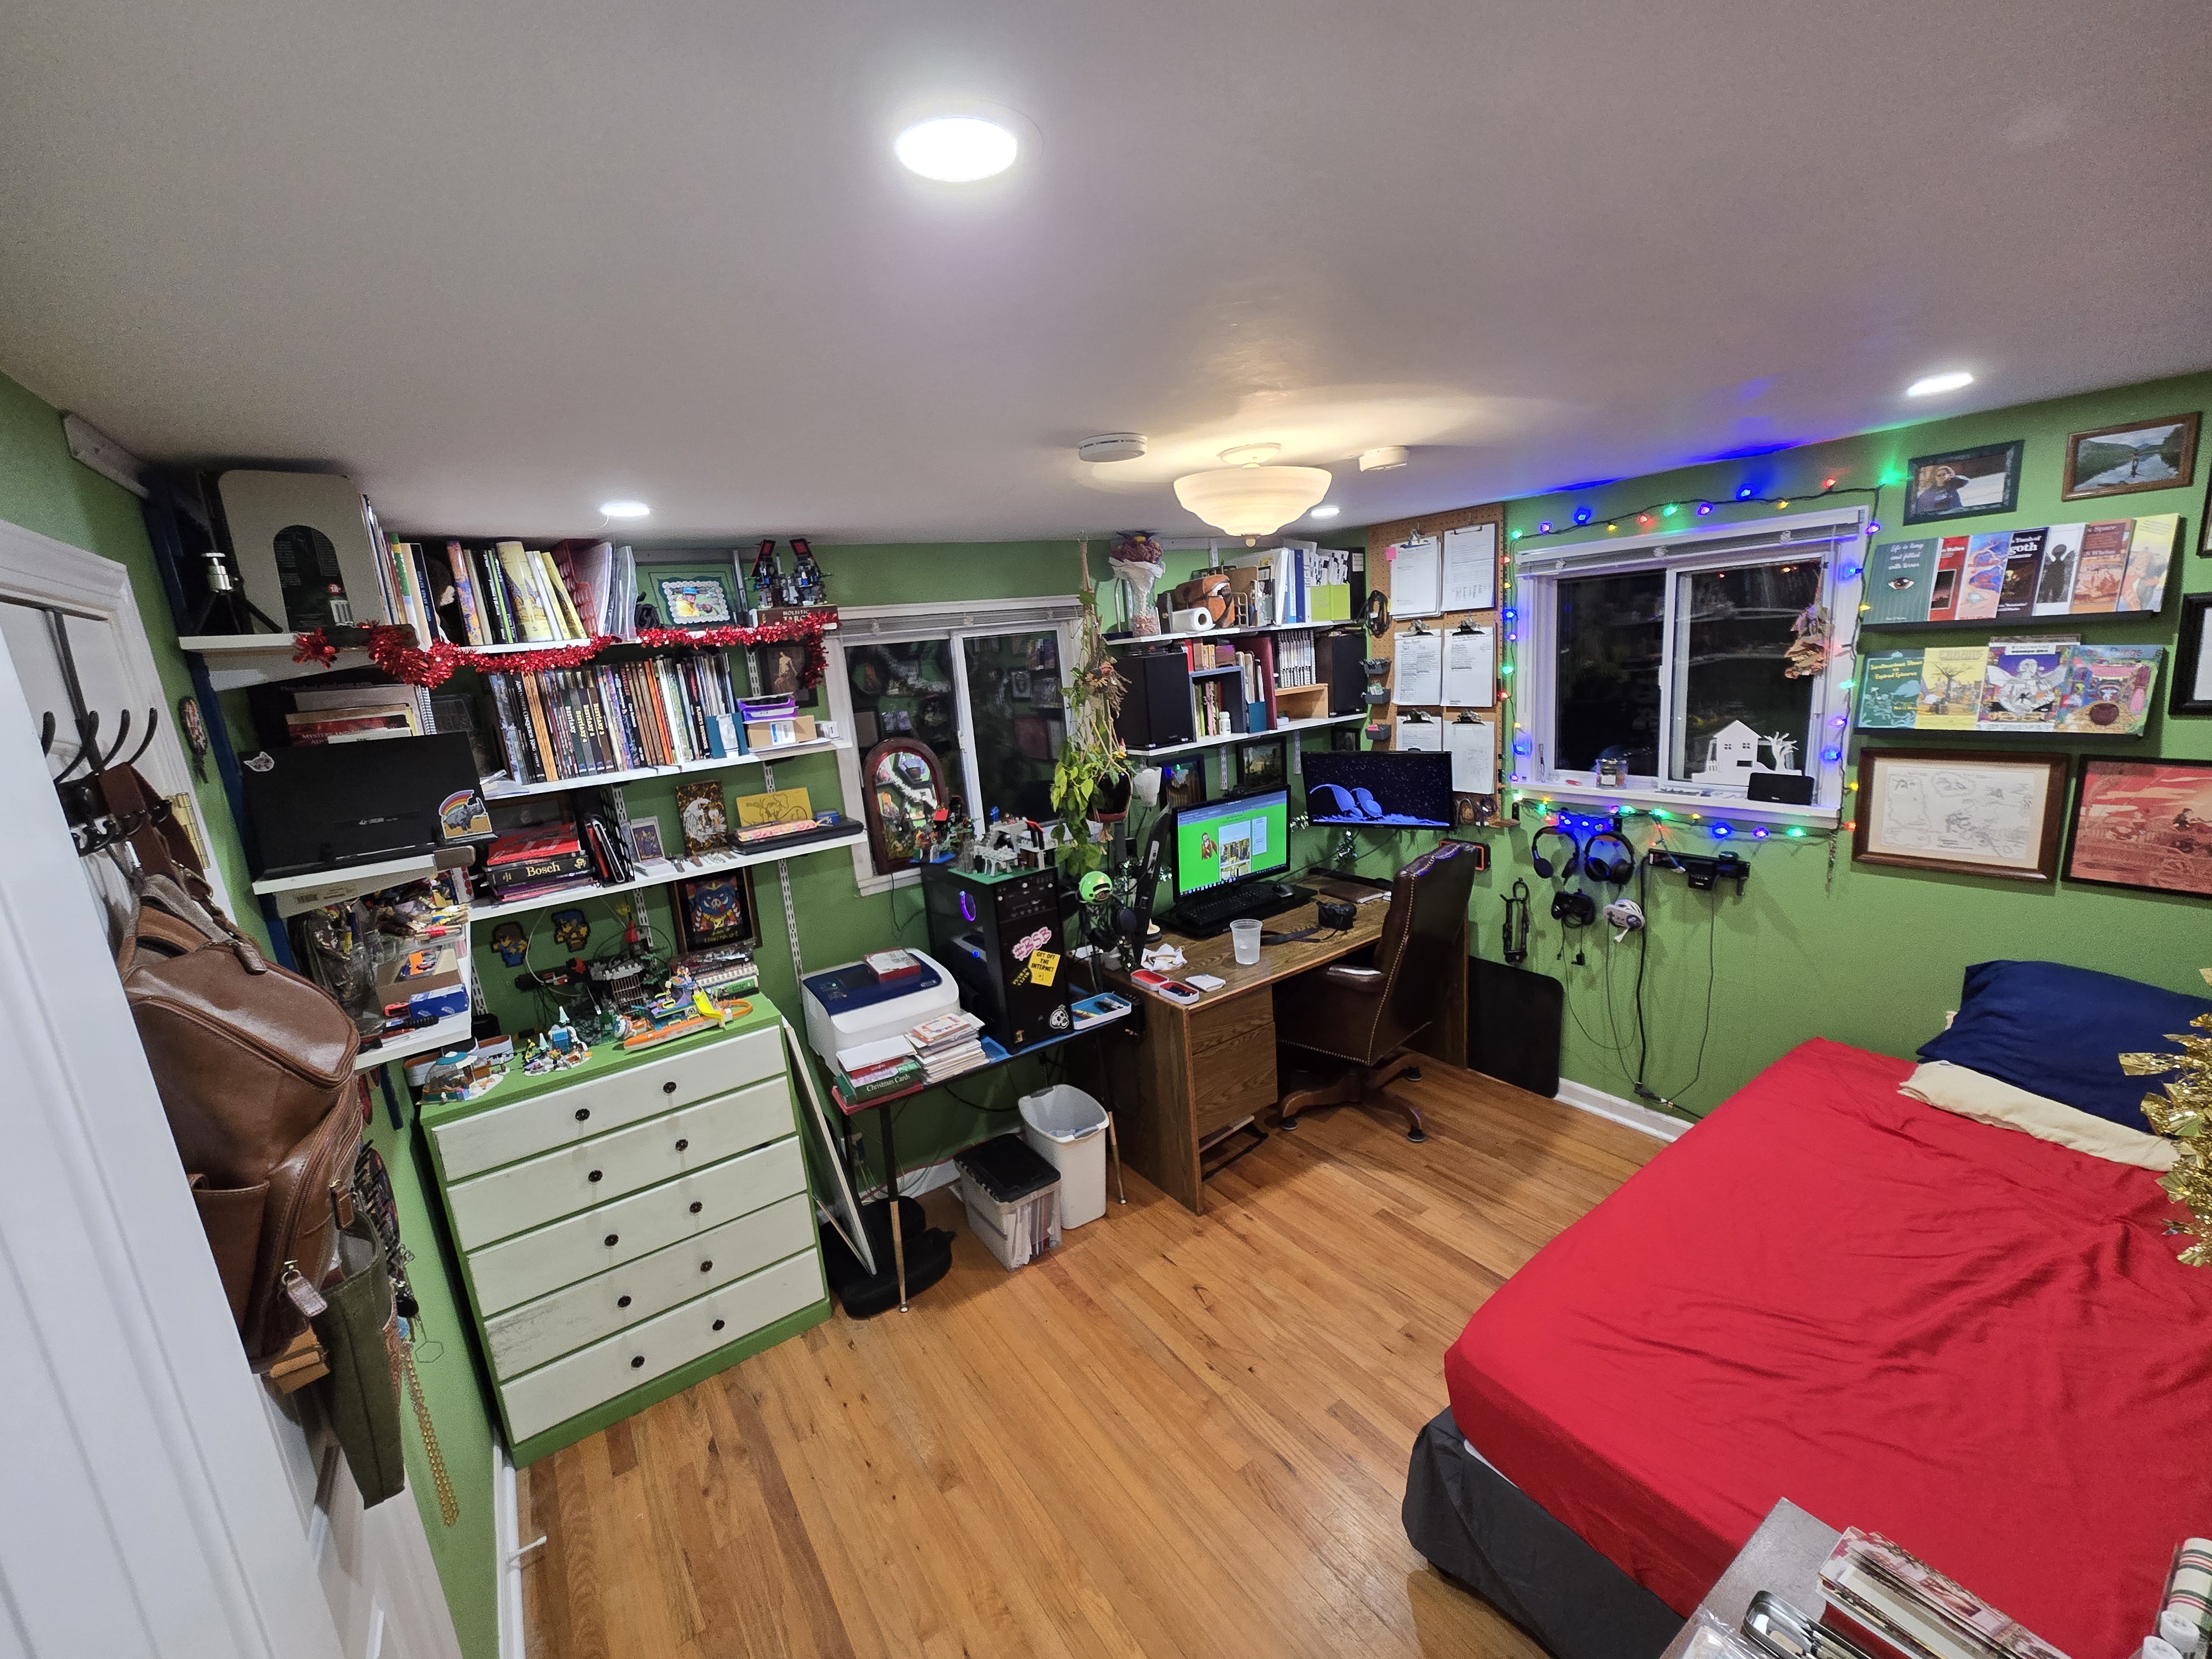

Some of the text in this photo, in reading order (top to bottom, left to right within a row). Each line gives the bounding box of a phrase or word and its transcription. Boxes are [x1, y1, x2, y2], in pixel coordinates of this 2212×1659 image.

[620, 668, 630, 696] TRAVELLER
[523, 710, 533, 739] CONQUEROR
[525, 861, 561, 877] Bosch
[1014, 928, 1051, 959] #BSB
[1031, 963, 1055, 972] INTERNET
[866, 1073, 911, 1092] Christmas Cards
